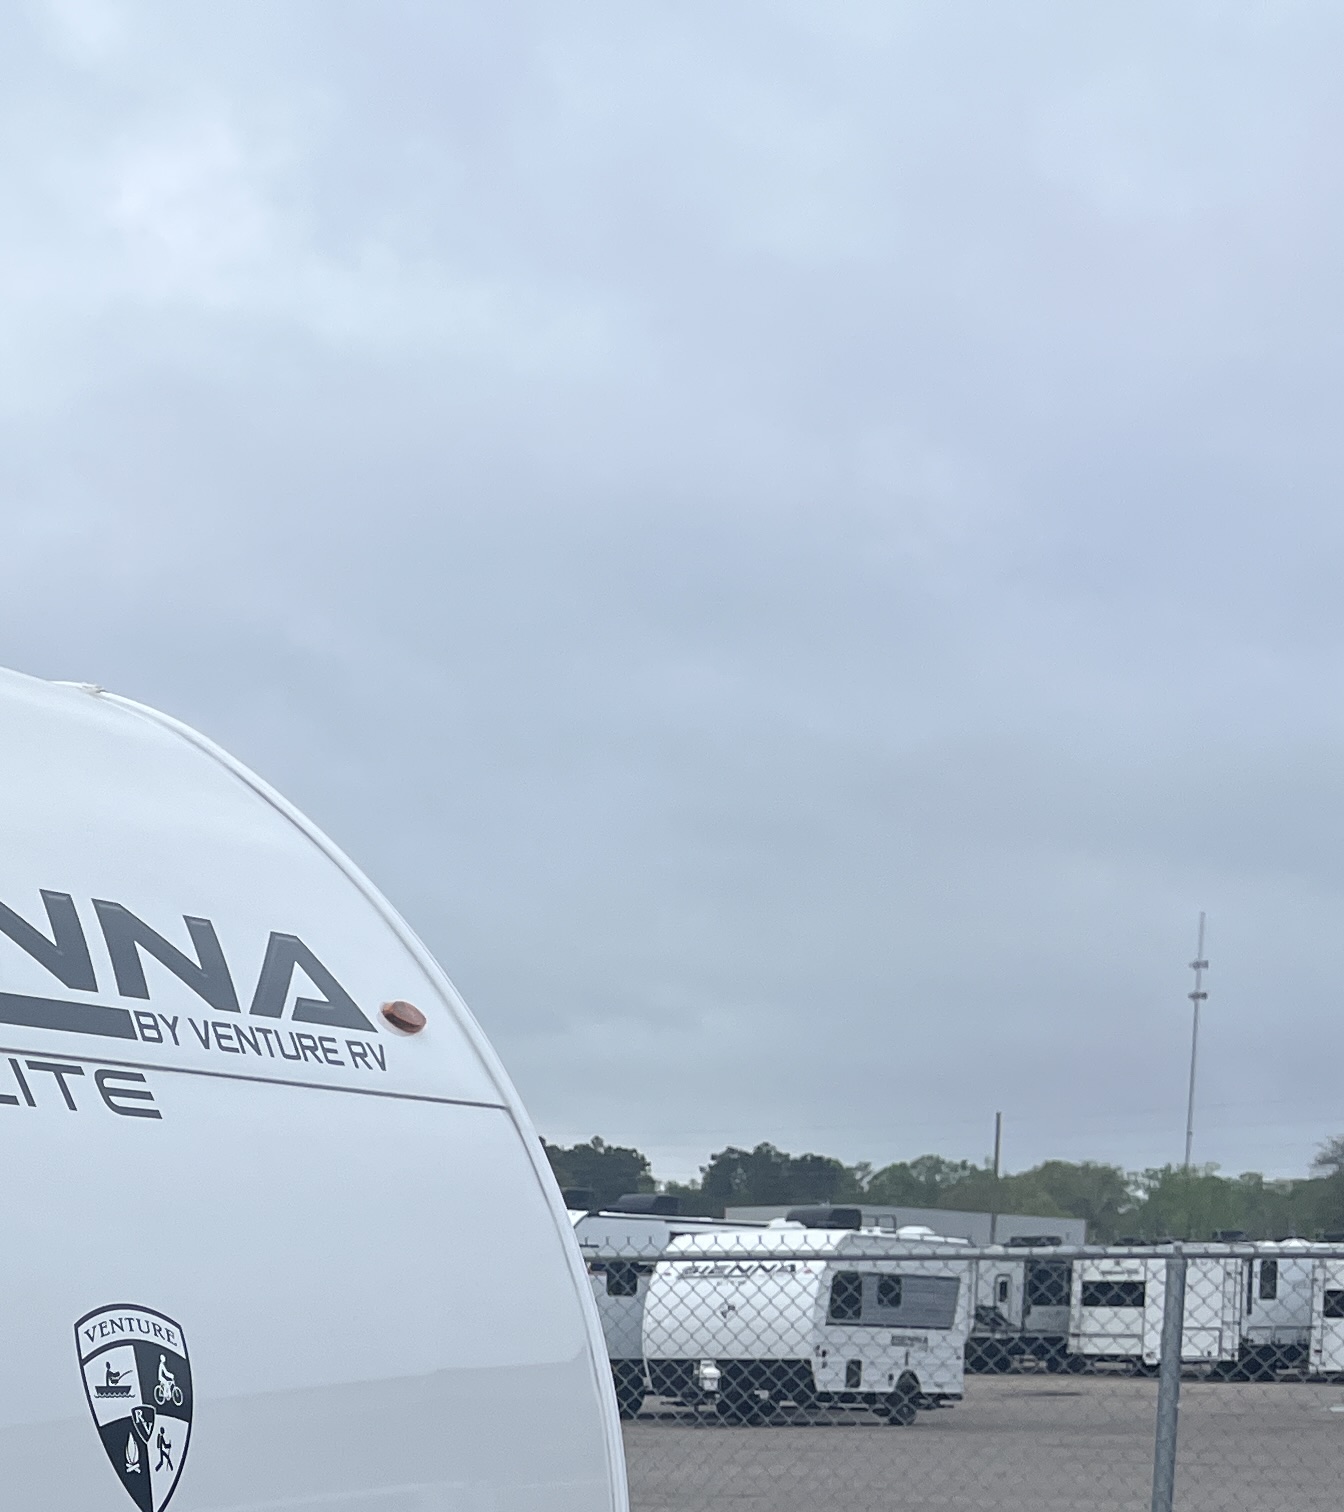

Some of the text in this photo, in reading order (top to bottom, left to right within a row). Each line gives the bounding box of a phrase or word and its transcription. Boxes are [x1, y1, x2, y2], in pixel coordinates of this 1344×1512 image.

[135, 1010, 389, 1072] BY VENTURE RV
[84, 1317, 178, 1347] VENTURE
